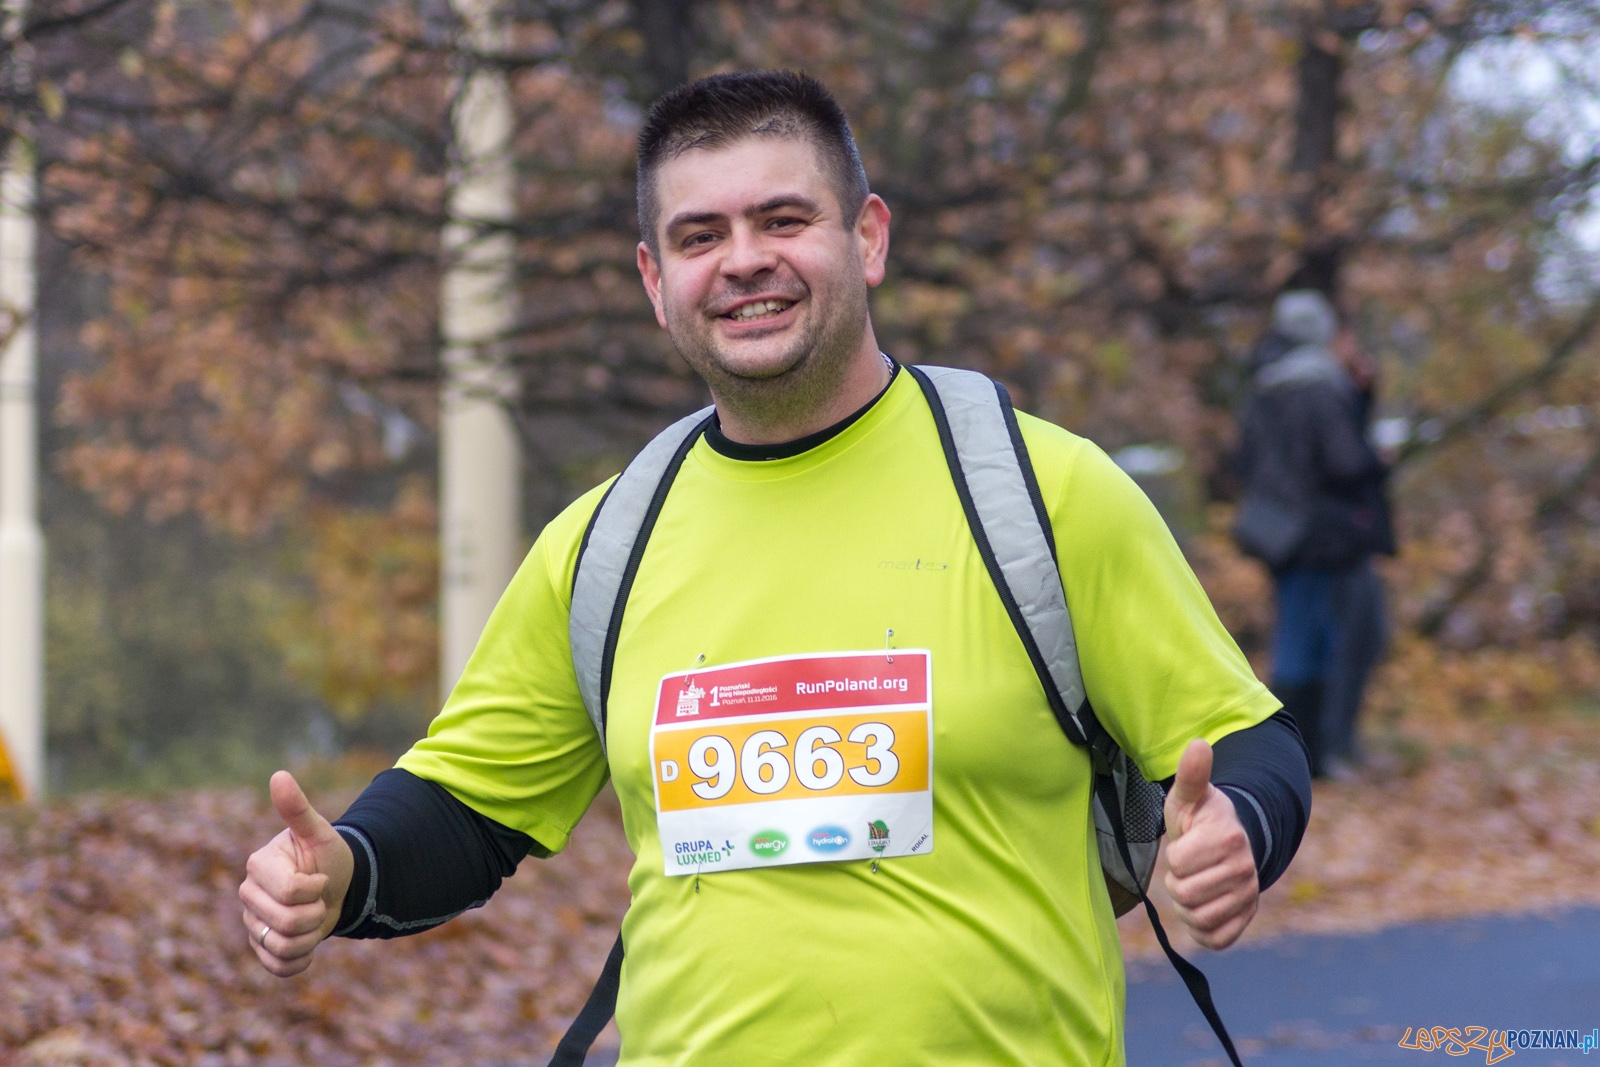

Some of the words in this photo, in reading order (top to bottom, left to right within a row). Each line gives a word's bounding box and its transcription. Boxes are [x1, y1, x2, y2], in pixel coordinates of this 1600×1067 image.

[796, 677, 908, 695] RunPoland.org
[709, 686, 721, 707] 1
[660, 759, 680, 783] D
[687, 722, 900, 800] 9663
[674, 839, 714, 854] GRUPA
[755, 839, 786, 852] energy
[911, 834, 929, 852] ROGAL
[676, 851, 722, 866] LUXMED
